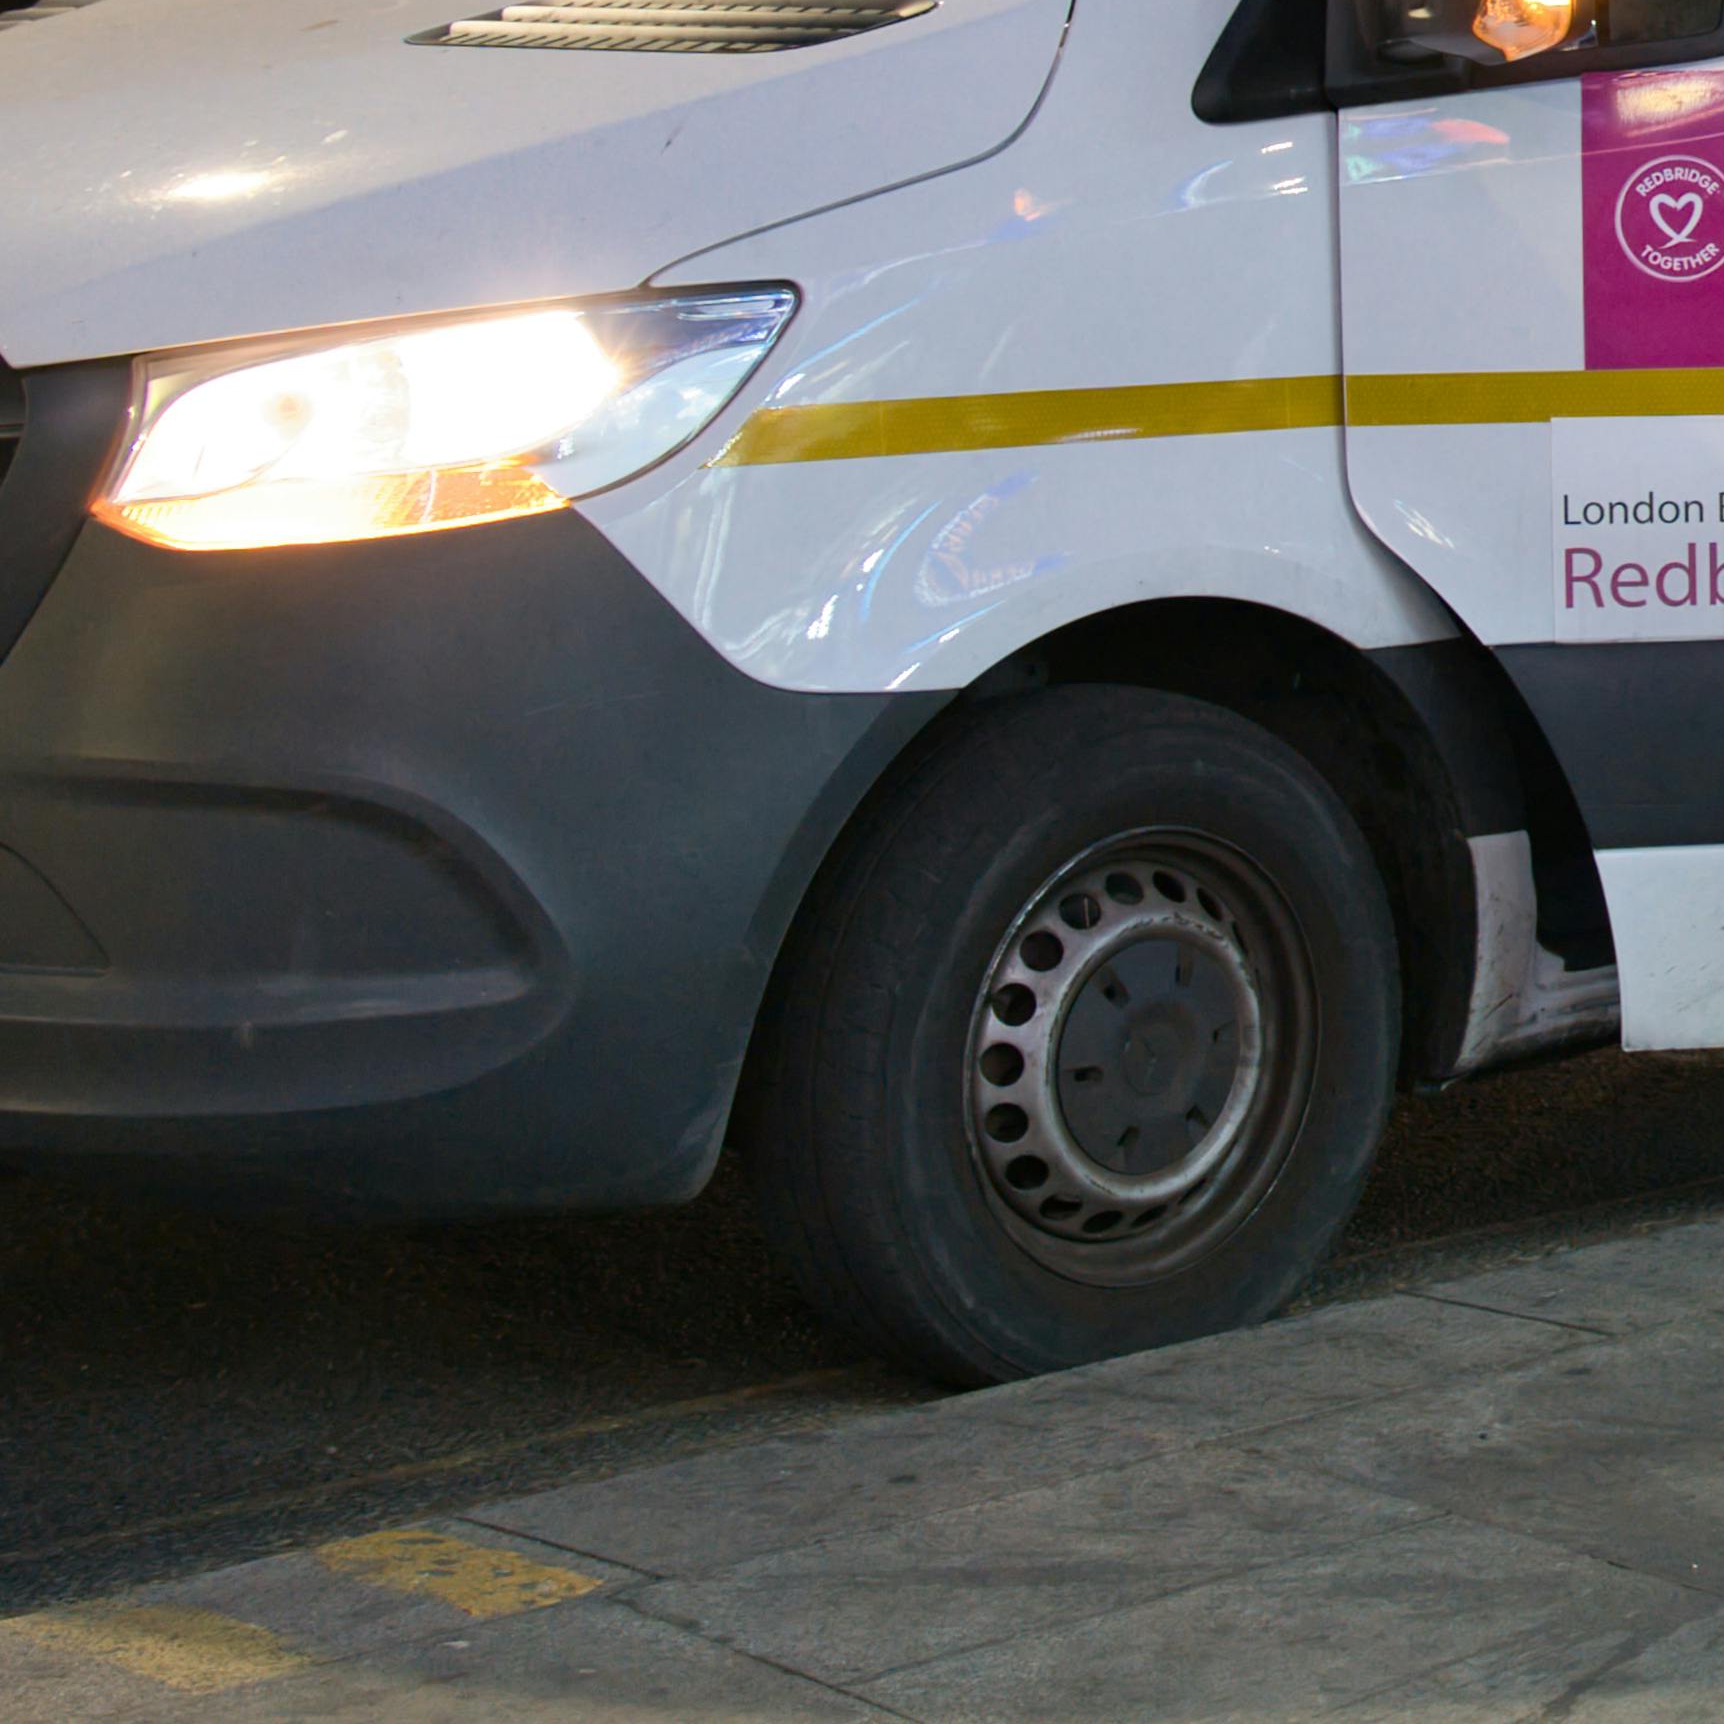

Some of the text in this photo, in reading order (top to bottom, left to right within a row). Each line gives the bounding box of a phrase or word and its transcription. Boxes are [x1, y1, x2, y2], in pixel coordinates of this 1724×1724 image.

[1635, 166, 1720, 197] REDBRIDGE
[1640, 242, 1720, 272] TOGETHER
[1562, 491, 1705, 526] London
